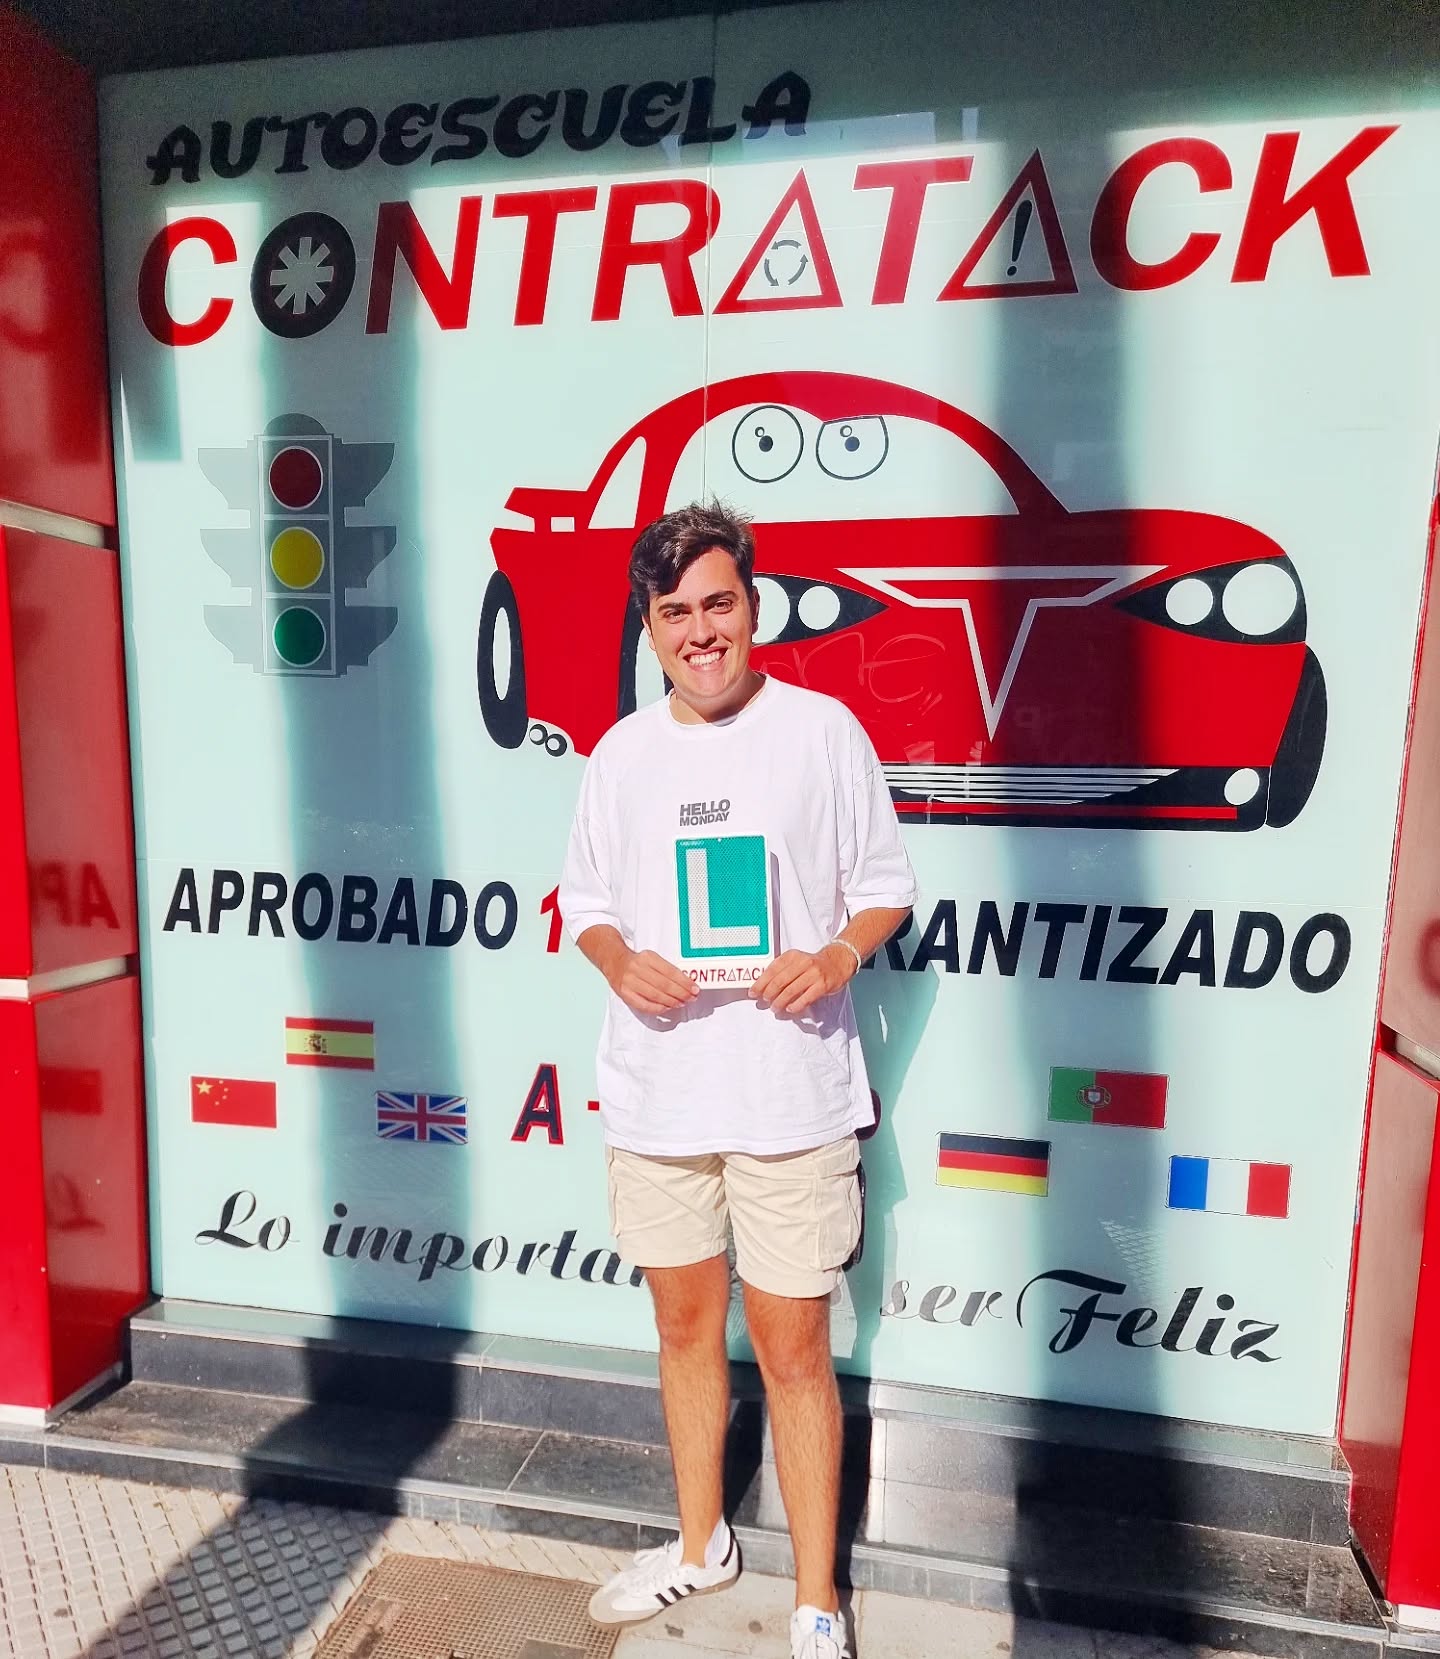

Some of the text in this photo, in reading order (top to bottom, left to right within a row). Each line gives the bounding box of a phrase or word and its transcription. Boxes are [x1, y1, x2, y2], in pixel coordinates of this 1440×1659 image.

[146, 71, 810, 185] AUTOESCUELA
[137, 124, 1401, 347] CONTRATACK
[679, 798, 731, 817] HELLO
[679, 811, 730, 827] MONDAY
[162, 867, 518, 951] APROBADO
[685, 848, 761, 950] L
[681, 967, 765, 982] ONTRATAC
[510, 1062, 564, 1146] A
[195, 1190, 299, 1252] Lo
[879, 1276, 1002, 1328] ser
[1017, 1269, 1282, 1363] Feliz
